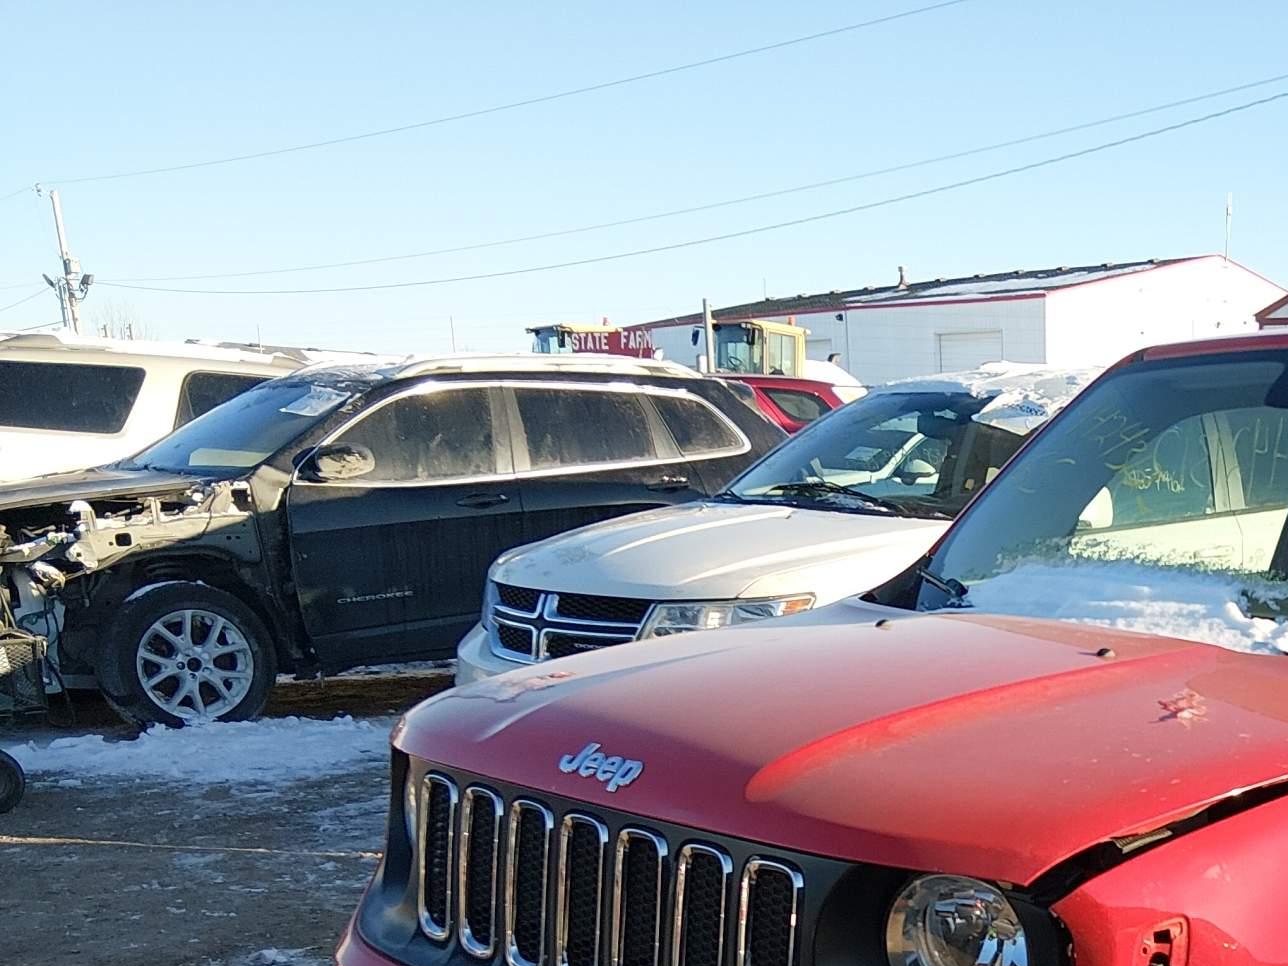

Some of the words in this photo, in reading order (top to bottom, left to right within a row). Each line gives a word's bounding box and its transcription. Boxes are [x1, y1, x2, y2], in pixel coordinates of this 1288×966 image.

[571, 332, 609, 351] STATE
[337, 591, 414, 604] CHEROKEE
[559, 742, 644, 793] Jeep
